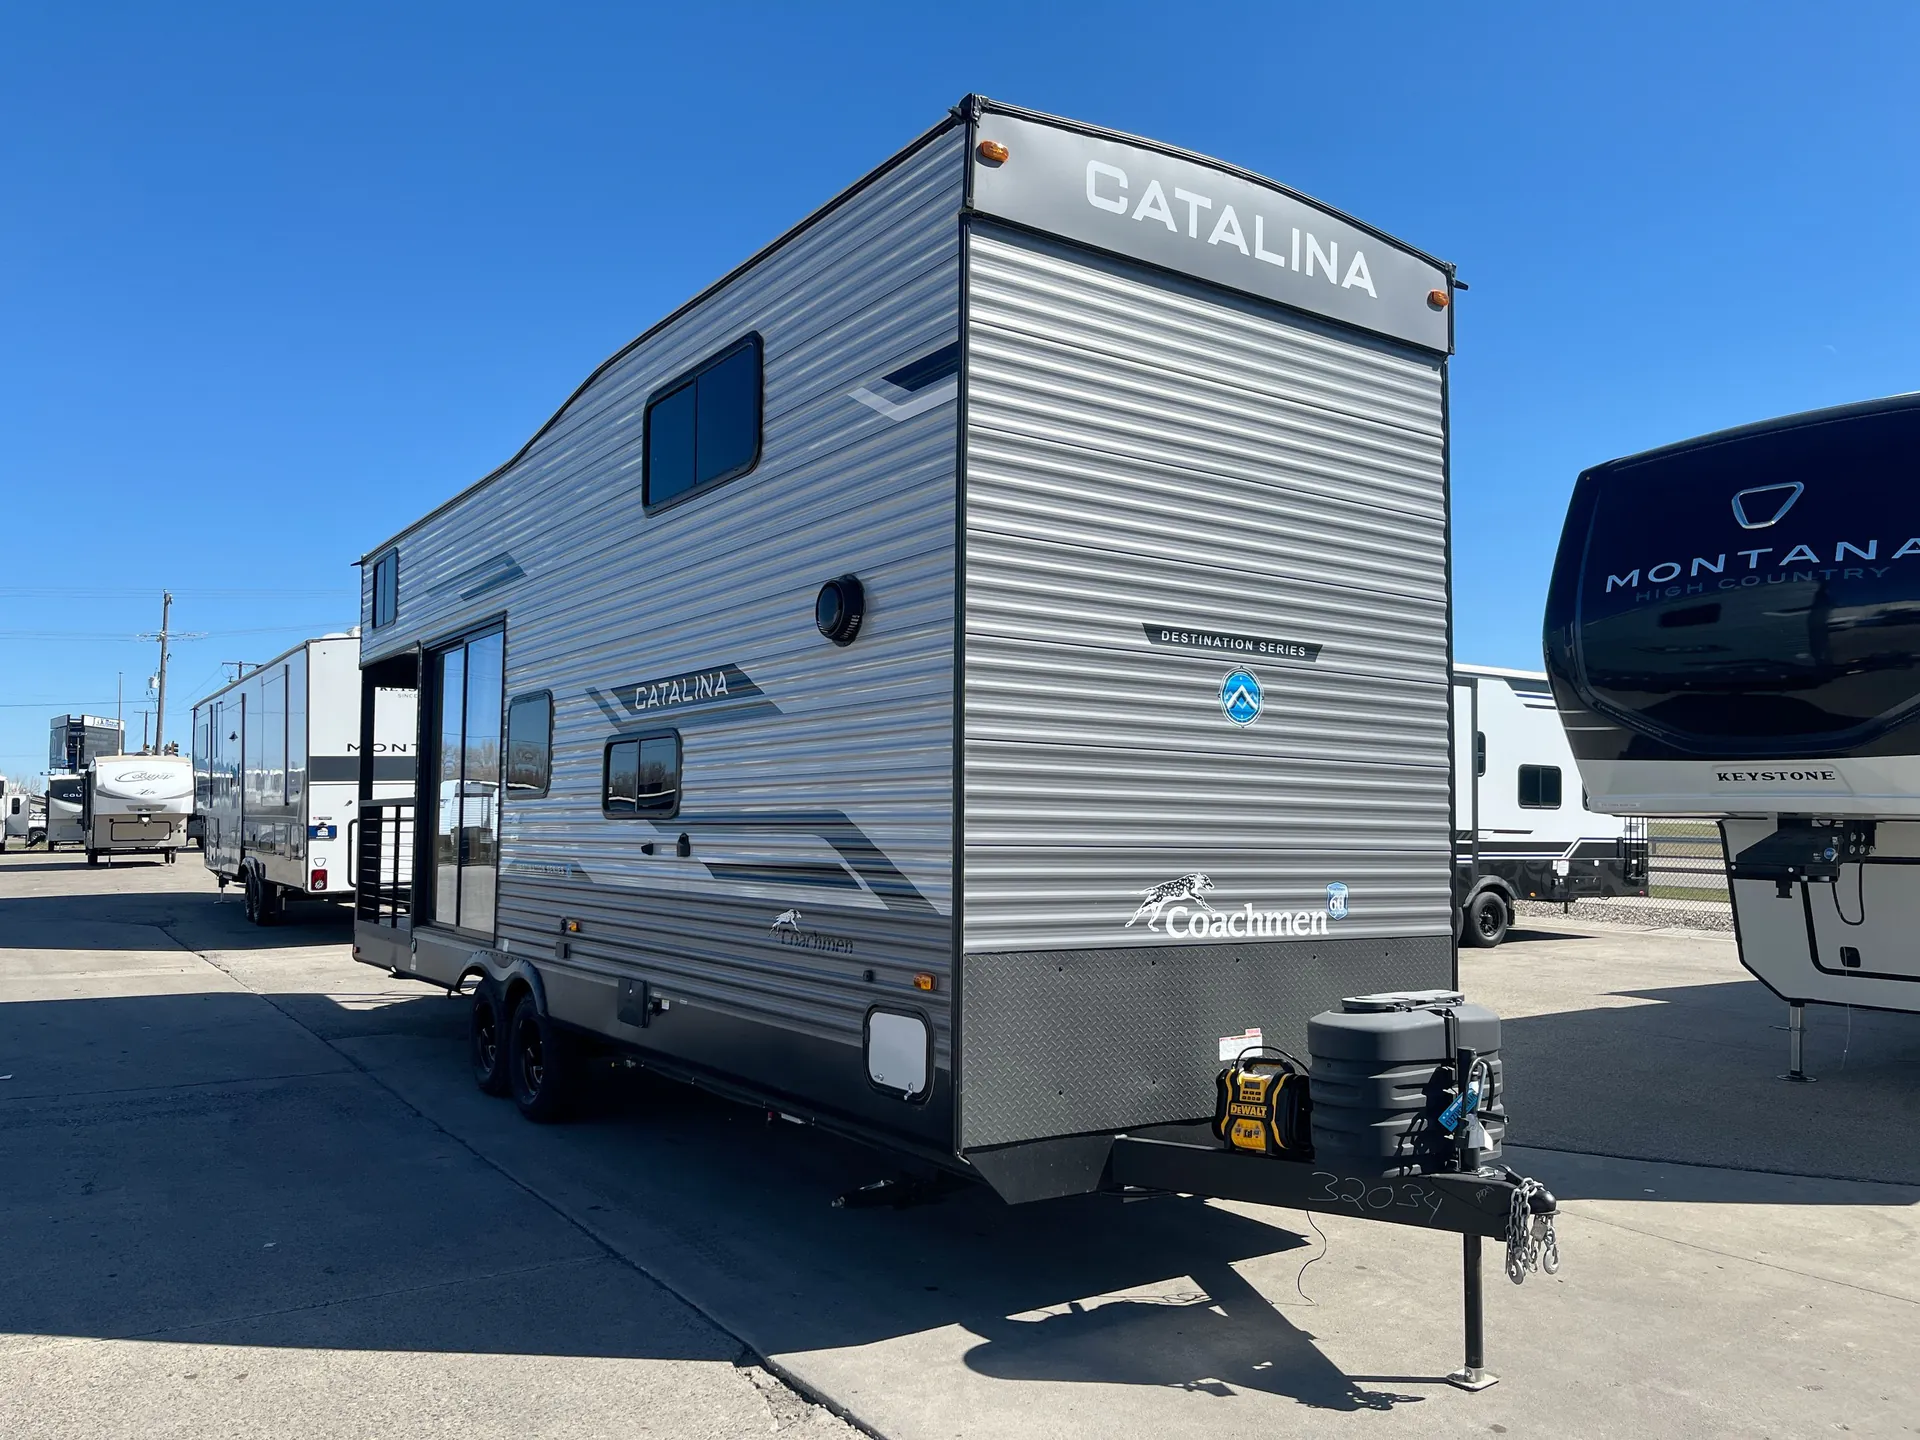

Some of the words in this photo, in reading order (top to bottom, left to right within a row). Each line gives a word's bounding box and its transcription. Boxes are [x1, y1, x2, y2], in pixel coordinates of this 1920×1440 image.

[1085, 159, 1378, 299] CATALINA
[1605, 537, 1920, 593] MONTANA
[1635, 582, 1704, 603] HIGH
[1717, 565, 1891, 591] COUNTRY
[1160, 630, 1254, 651] DESTINATION
[1259, 642, 1306, 657] SERIES
[634, 671, 729, 710] CATALINA
[1716, 770, 1836, 783] KEYSTONE
[1165, 902, 1330, 939] Coachmen
[781, 928, 854, 955] Coachmen
[1307, 1171, 1444, 1225] 32034
